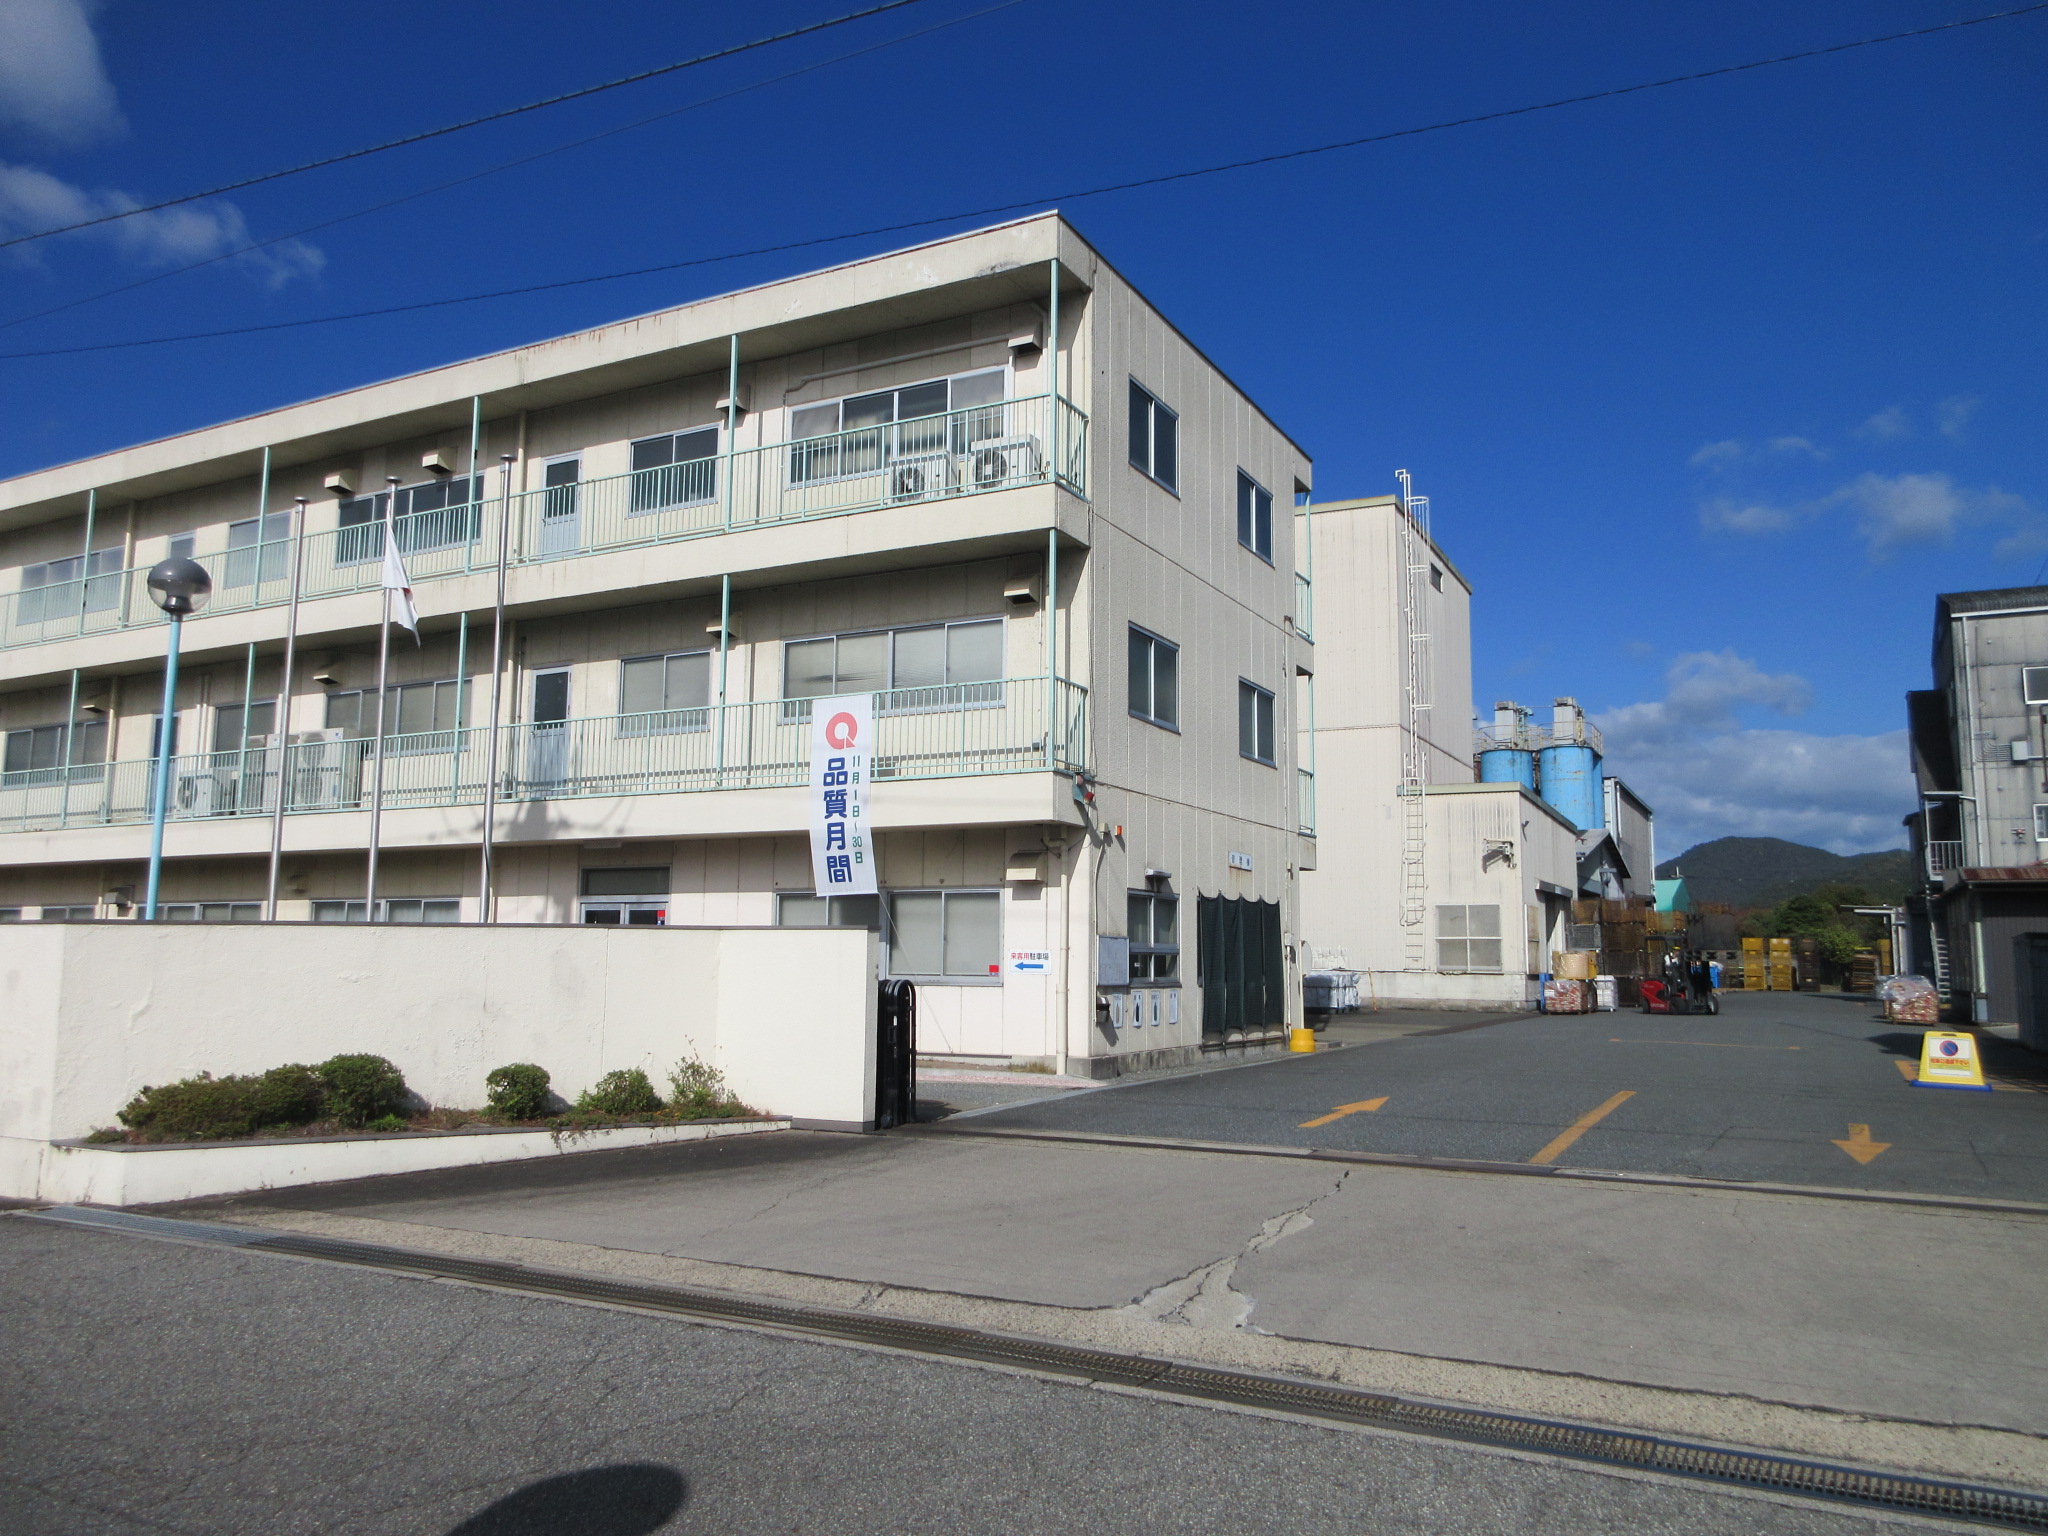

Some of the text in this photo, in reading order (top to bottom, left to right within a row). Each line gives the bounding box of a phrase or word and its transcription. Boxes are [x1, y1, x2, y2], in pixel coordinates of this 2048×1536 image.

[826, 712, 858, 750] Q
[823, 757, 852, 884] 品質月間
[1010, 952, 1049, 961] 来客用駐車場
